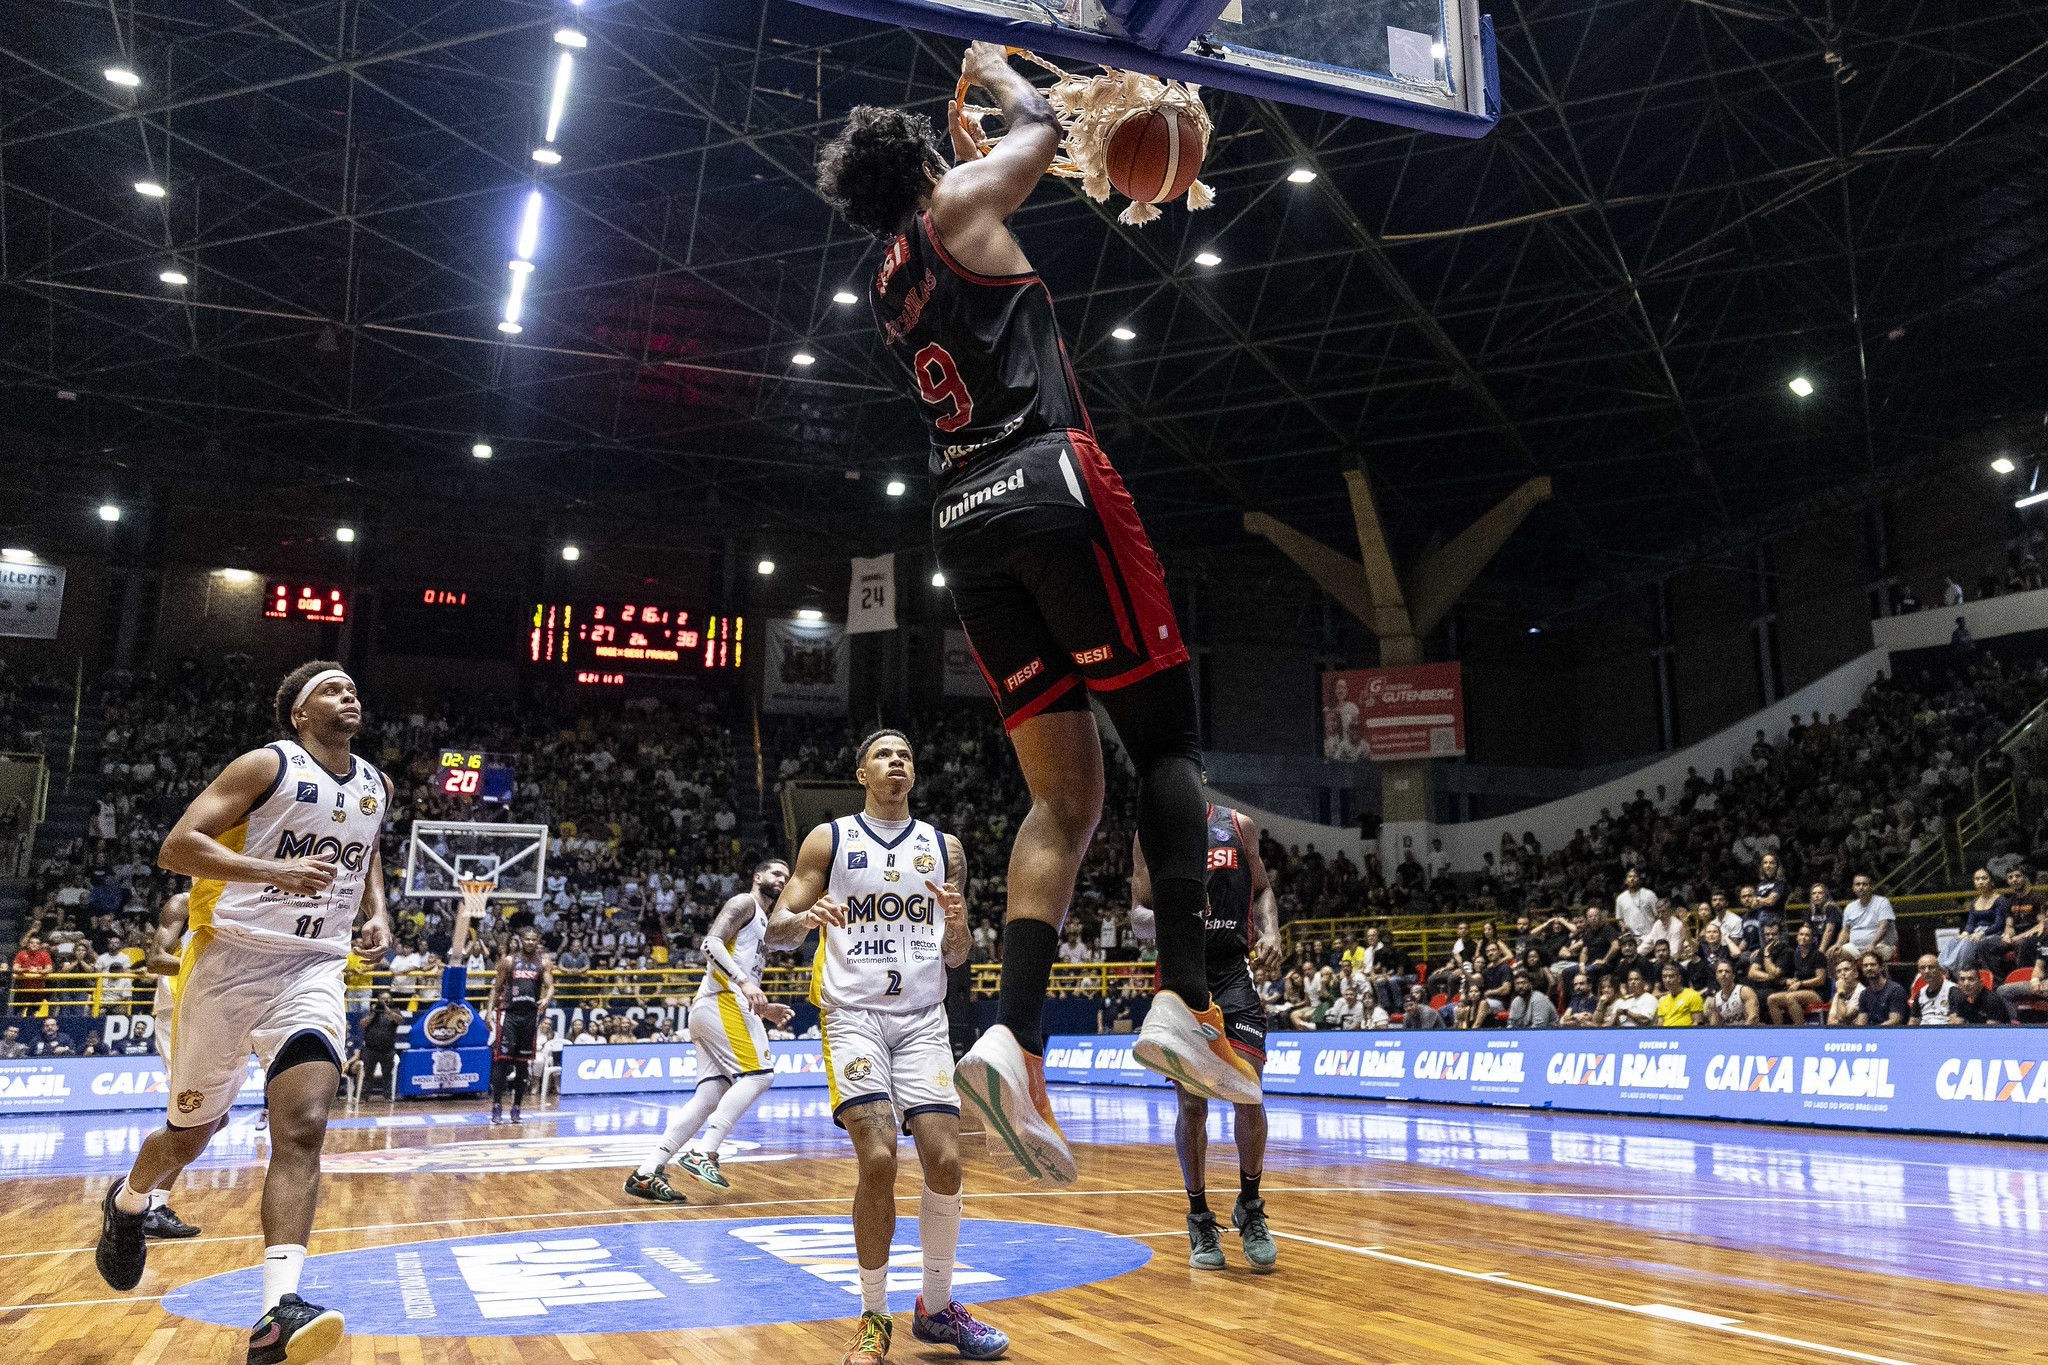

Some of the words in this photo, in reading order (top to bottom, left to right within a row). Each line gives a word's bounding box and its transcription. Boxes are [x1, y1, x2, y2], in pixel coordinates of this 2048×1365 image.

[914, 342, 974, 432] 9
[939, 469, 1025, 529] Unimed
[862, 587, 885, 610] 24
[591, 624, 615, 641] 27
[676, 630, 698, 647] 38
[1075, 648, 1108, 665] SESI
[1007, 660, 1040, 691] FIESP
[1382, 688, 1454, 703] GUTENBERG
[441, 752, 482, 769] 02:16
[445, 769, 480, 793] 20
[847, 893, 935, 925] MOGI
[295, 914, 325, 939] 11
[847, 924, 934, 936] BASQUETE
[1205, 918, 1238, 930] tshoes
[864, 939, 898, 956] HIC
[846, 956, 898, 965] Investimentos
[884, 970, 903, 996] 2
[1824, 1043, 1863, 1053] GOVERNO
[1865, 1043, 1878, 1053] DO
[577, 1057, 664, 1080] CAIXA
[771, 1053, 827, 1074] AIX
[1314, 1050, 1361, 1077] CAIXA
[1360, 1050, 1406, 1078] BRASIL
[1414, 1050, 1469, 1081] CAIXA
[1470, 1051, 1525, 1082] BRASIL
[1546, 1052, 1616, 1087] CAIXA
[1619, 1053, 1691, 1090] BRASIL
[0, 1074, 71, 1098] RASIL
[91, 1071, 170, 1096] CAIX
[1705, 1054, 1794, 1093] CAIXA
[1800, 1056, 1896, 1099] BRASIL
[1935, 1058, 2048, 1104] CAIXA
[450, 1237, 668, 1319] BRASIL
